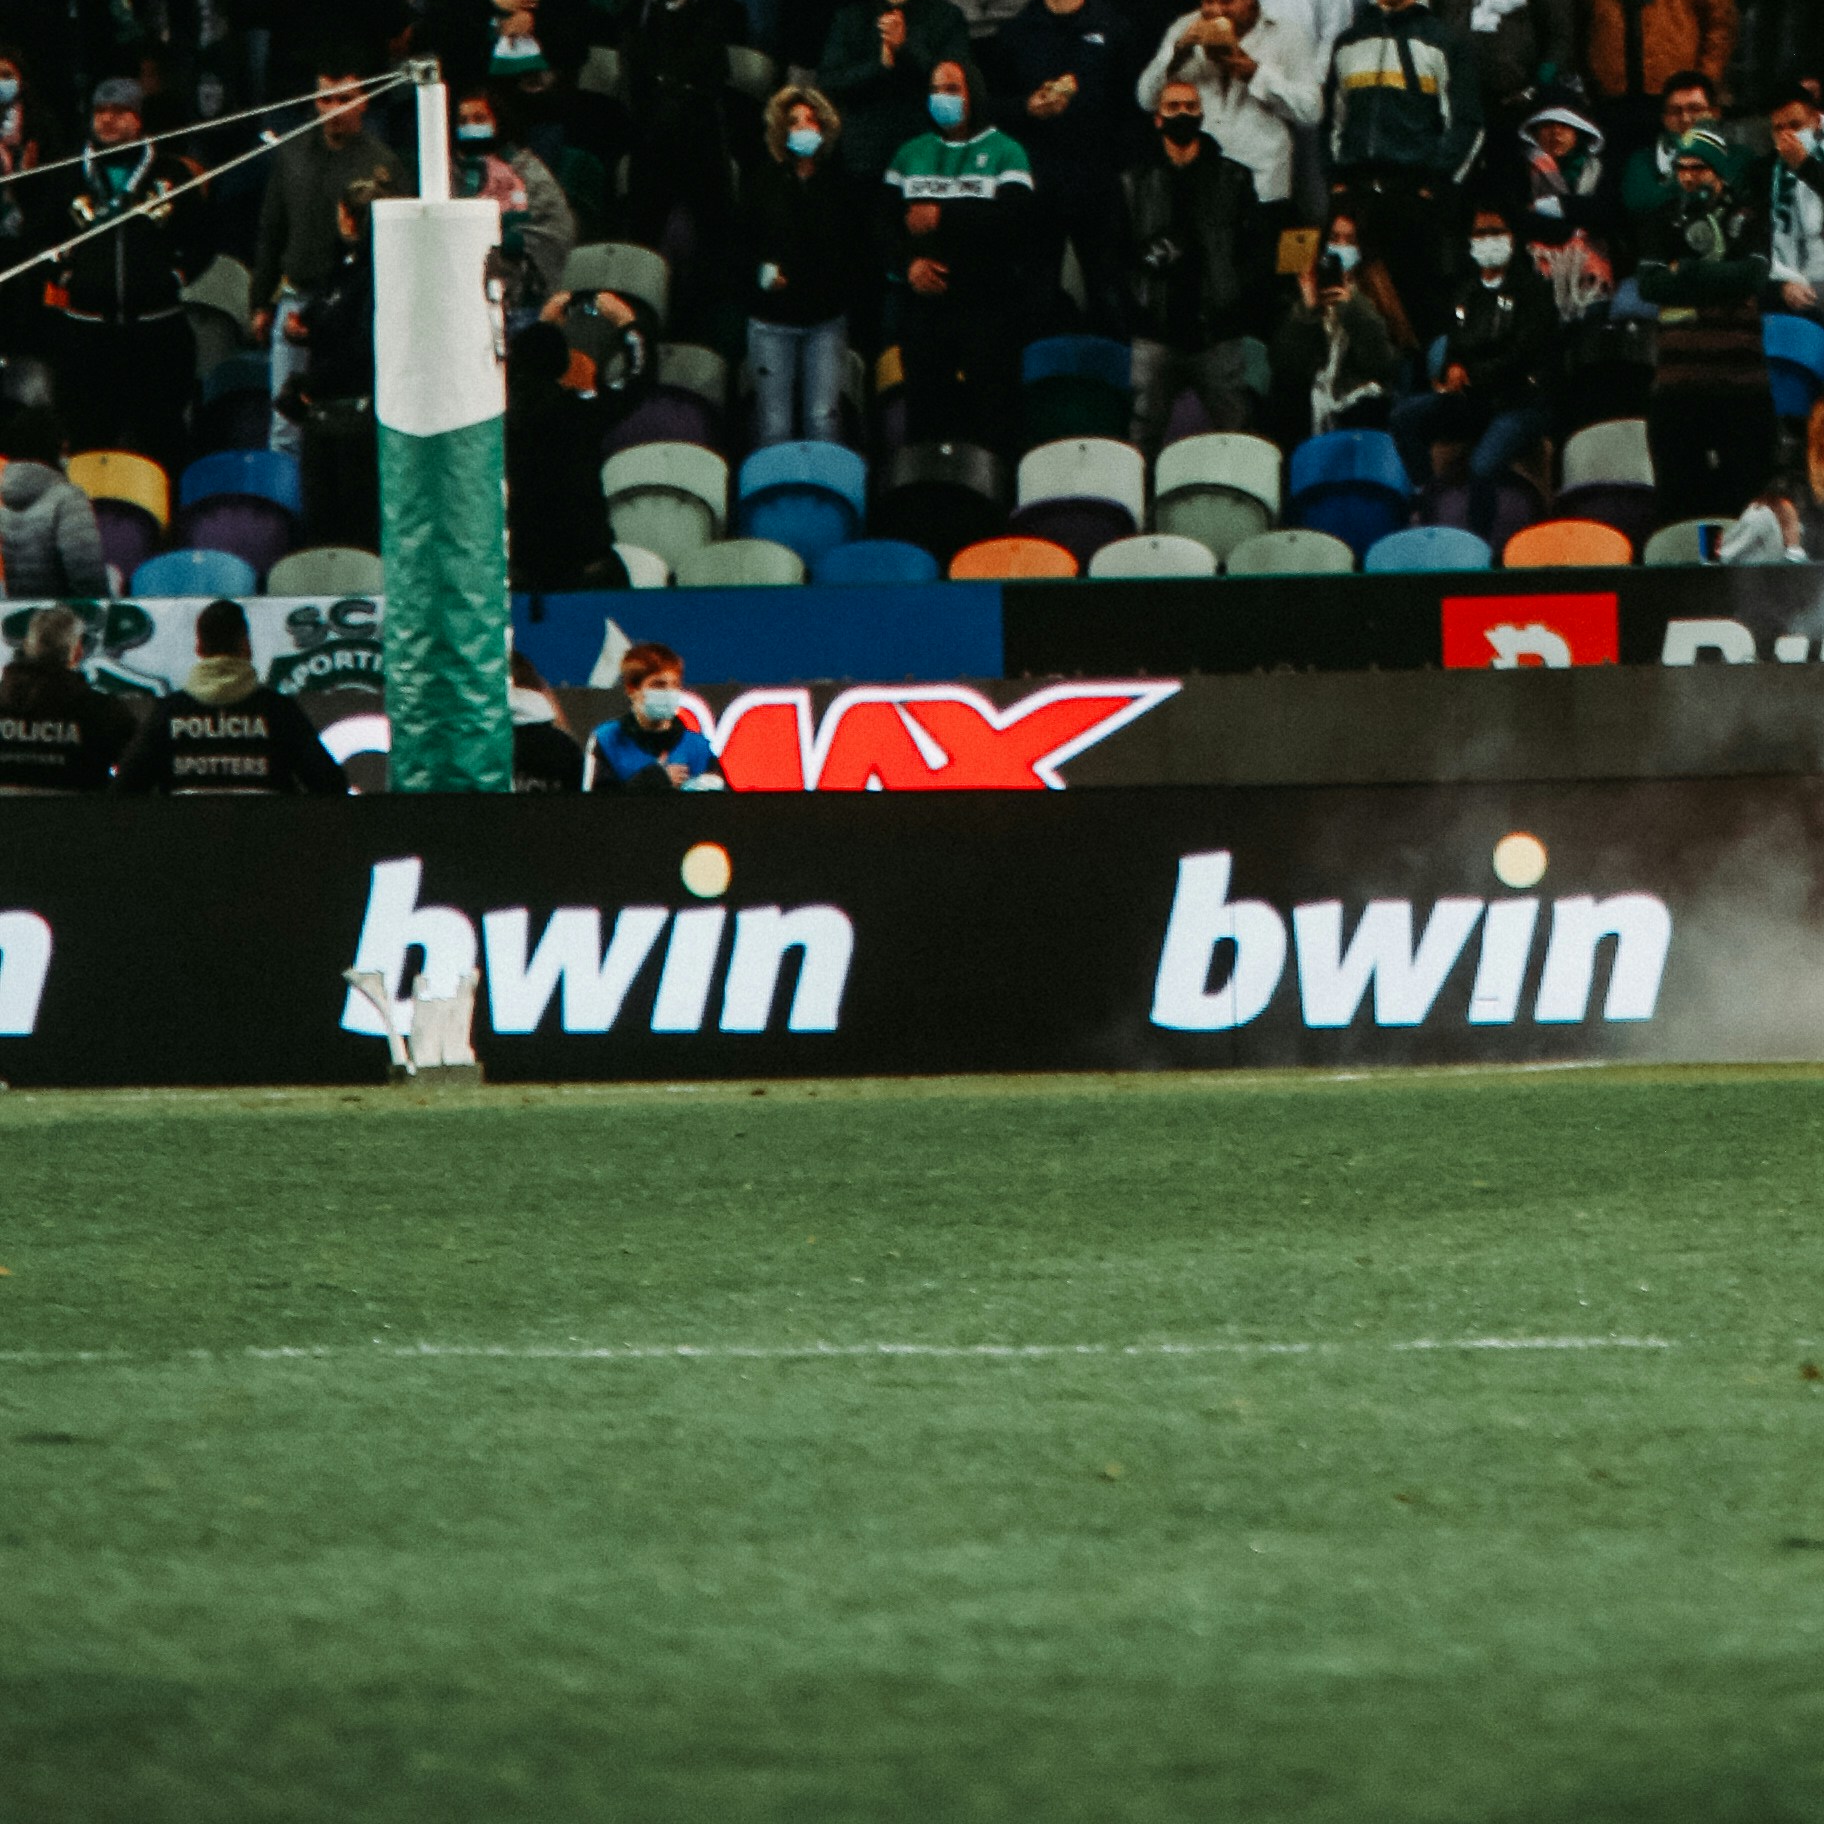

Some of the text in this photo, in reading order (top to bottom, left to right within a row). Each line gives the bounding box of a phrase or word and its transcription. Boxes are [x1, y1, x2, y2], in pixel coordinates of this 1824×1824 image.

[170, 709, 269, 739] POLÍCIA
[341, 841, 854, 1035] bwin
[1150, 831, 1672, 1031] bwin
